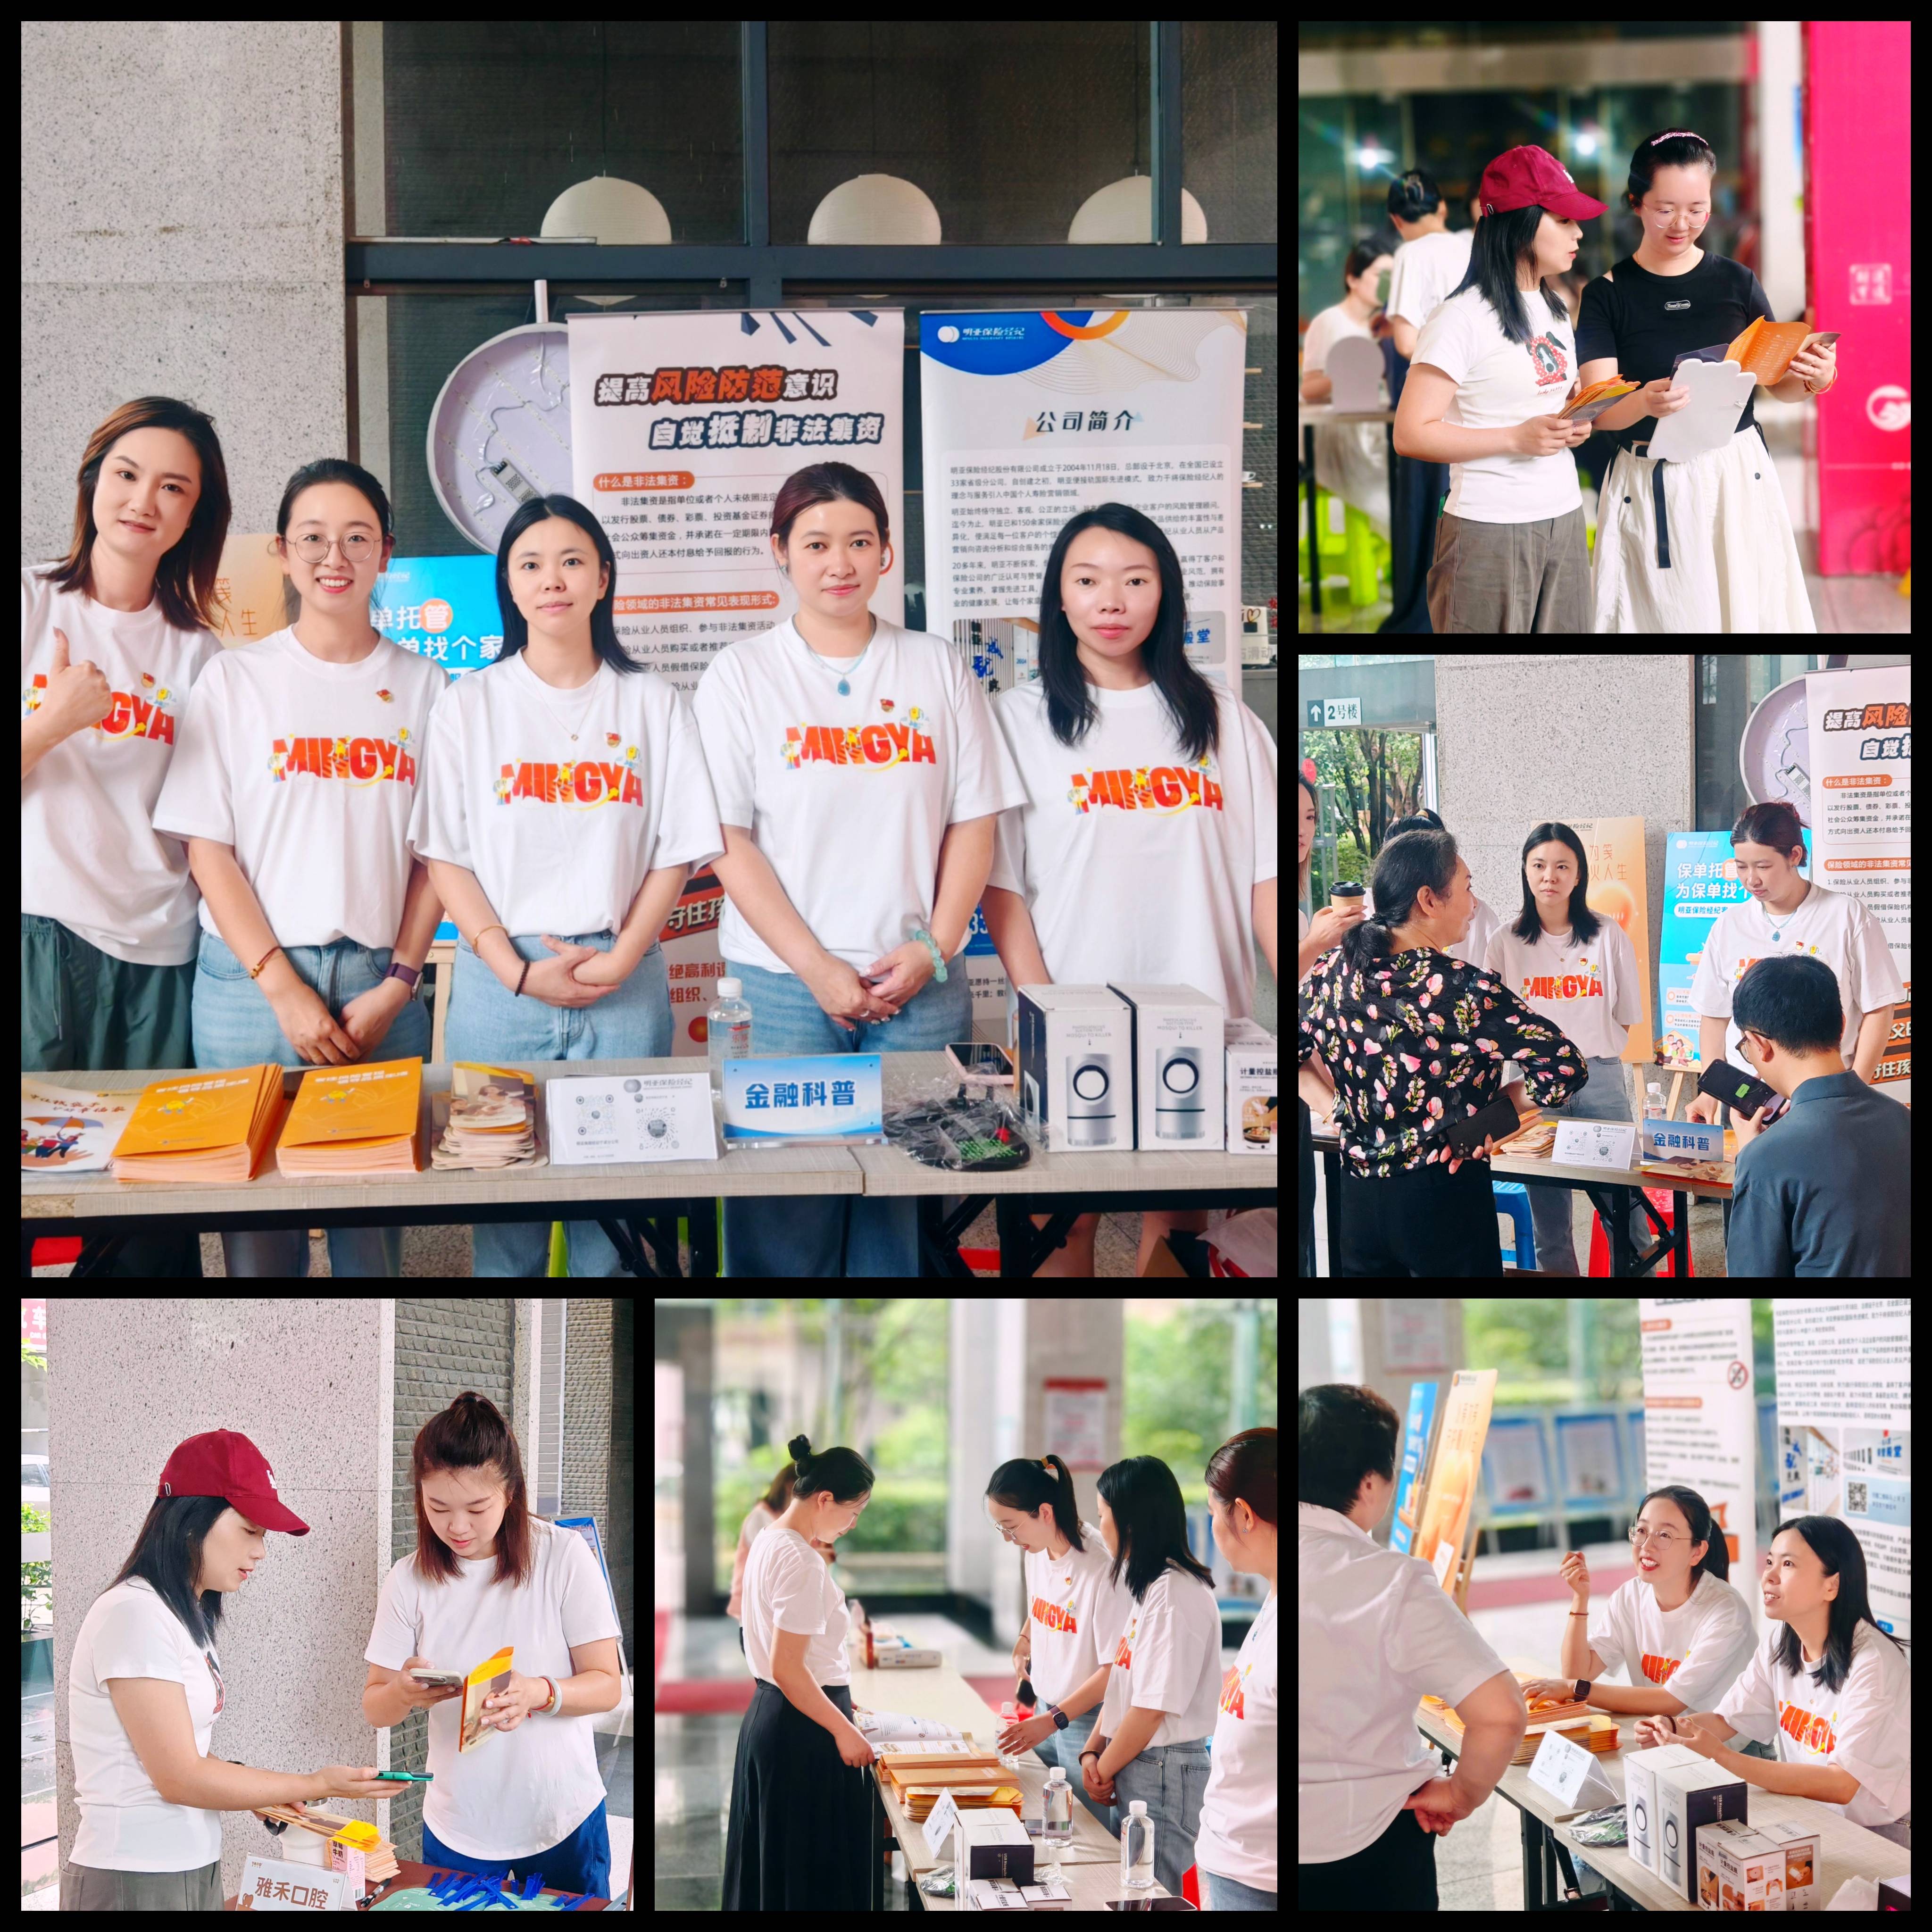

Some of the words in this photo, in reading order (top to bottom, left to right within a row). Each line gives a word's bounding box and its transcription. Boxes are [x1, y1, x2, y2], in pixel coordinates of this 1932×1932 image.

[962, 327, 1024, 336] 明亚保险经纪
[595, 365, 838, 406] 提高风险防范意识
[649, 410, 884, 450] 自觉抵制非法集资
[1036, 410, 1134, 433] 公司简介
[599, 475, 687, 488] 什么是非法集资：
[621, 493, 777, 506] 非法集资是指单位或者个人未依照法定
[221, 608, 258, 637] 人生
[1328, 703, 1357, 721] 2号楼
[785, 722, 936, 768] MINGYA
[272, 737, 415, 786] MINGYA
[501, 761, 643, 808] MINGYA
[1071, 766, 1223, 813] MINGYA
[1523, 975, 1604, 1001] MINGYA
[644, 1078, 692, 1086] 明亚保险经纪
[745, 1080, 855, 1109] 金融科普
[1653, 1133, 1710, 1151] 金融科普
[255, 1877, 328, 1910] 雅禾口腔
